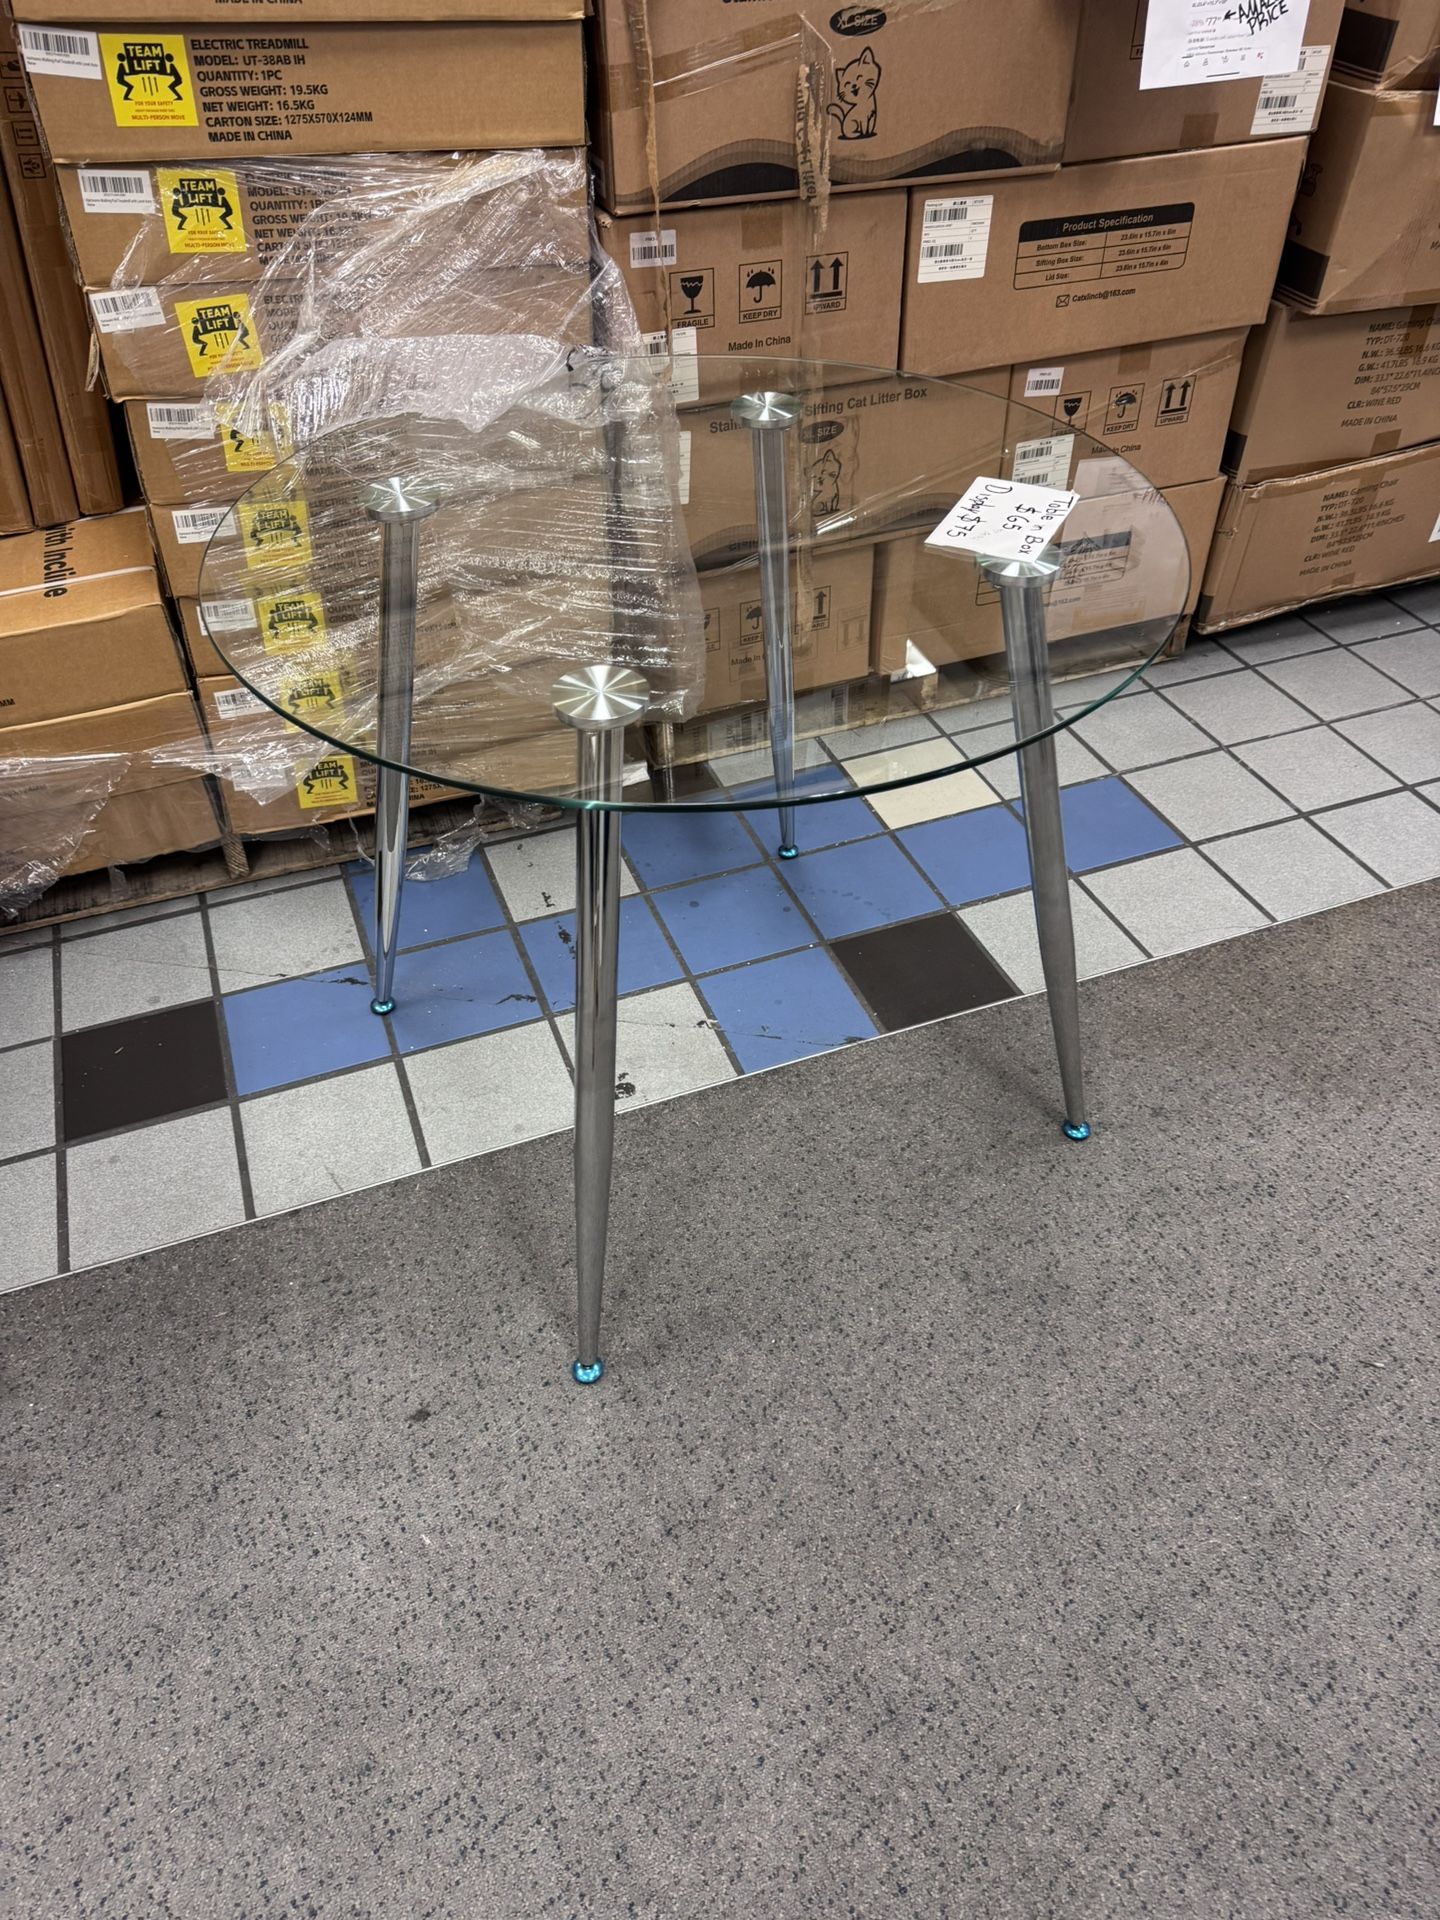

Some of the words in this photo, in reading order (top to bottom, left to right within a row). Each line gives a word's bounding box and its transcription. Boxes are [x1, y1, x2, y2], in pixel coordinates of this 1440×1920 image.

[854, 15, 878, 26] SIZE
[1247, 2, 1289, 36] PRICE
[191, 39, 244, 50] ELECTRIC
[246, 38, 309, 49] TREADMILL
[126, 45, 162, 57] TEAM
[133, 60, 160, 71] LIFT
[194, 56, 239, 66] MODEL:
[242, 55, 291, 66] UT-38AB
[293, 55, 306, 65] IH
[197, 71, 259, 82] QUANTITY:
[261, 70, 283, 81] 1PC
[200, 86, 238, 97] GROSS
[240, 86, 287, 96] WEIGHT:
[290, 84, 328, 95] 19.5KG
[202, 102, 224, 112] NET
[227, 101, 274, 112] WEIGHT:
[276, 100, 315, 111] 16.5KG
[205, 117, 253, 128] CARTON
[255, 116, 282, 127] SIZE:
[285, 112, 373, 124] 1275X570X124MM
[208, 132, 242, 142] MADE
[243, 131, 255, 141] IN
[257, 130, 293, 141] CHINA
[181, 181, 215, 191] TEAM
[188, 193, 213, 203] LIFT
[250, 200, 307, 211] QUANTITY:
[252, 214, 288, 225] GROSS
[1062, 220, 1097, 232] Product
[1099, 213, 1154, 230] Specification
[254, 229, 274, 239] NET
[1037, 243, 1059, 251] Bottom
[1073, 240, 1087, 248] Size:
[1036, 258, 1056, 267] Sifting
[1057, 257, 1069, 265] Box
[1070, 255, 1084, 263] Size:
[1056, 272, 1069, 280] Size:
[200, 307, 230, 318] TEAM
[742, 311, 762, 321] KEEP
[763, 309, 778, 319] DRY
[206, 318, 230, 330] LIFT
[677, 318, 709, 328] FRAGILE
[1369, 321, 1394, 332] NAME:
[728, 341, 753, 352] Made
[755, 338, 764, 348] In
[765, 335, 791, 346] China
[1366, 335, 1382, 345] TYP:
[804, 402, 844, 417] Sifting
[847, 396, 867, 409] Cat
[869, 392, 902, 406] Litter
[904, 387, 928, 399] Box
[1347, 400, 1365, 409] CLR:
[1386, 396, 1402, 406] RED
[1341, 417, 1364, 427] MADE
[1364, 416, 1374, 425] IN
[1374, 414, 1398, 424] CHINA
[816, 425, 837, 437] SIZE
[1120, 443, 1142, 454] China
[1323, 490, 1349, 502] NAME:
[1019, 534, 1044, 555] Box
[731, 656, 752, 666] Made
[317, 761, 336, 769] EAM
